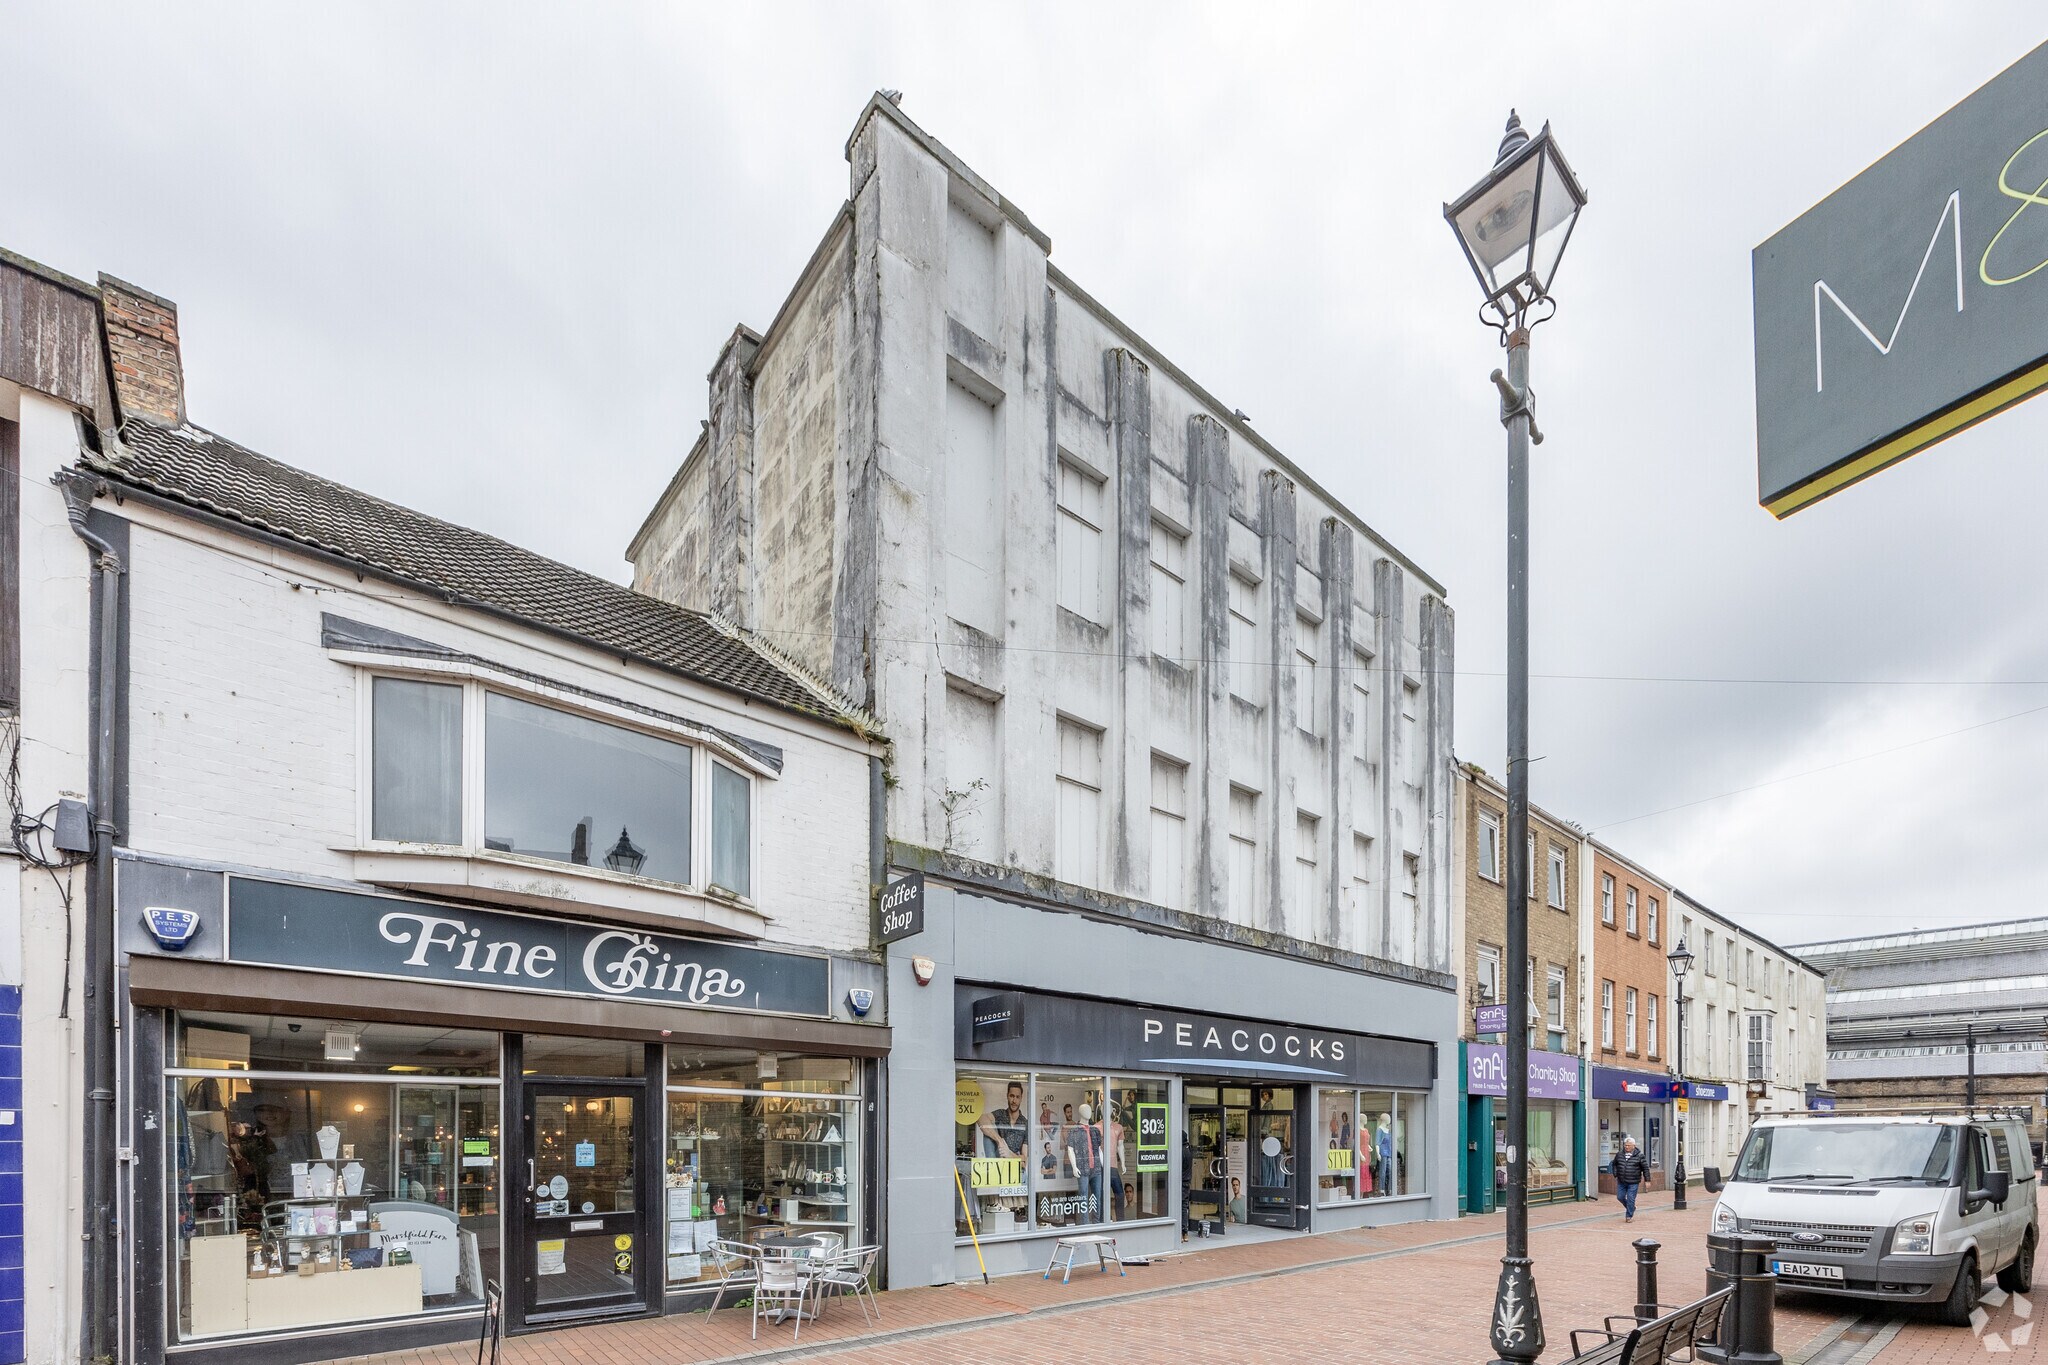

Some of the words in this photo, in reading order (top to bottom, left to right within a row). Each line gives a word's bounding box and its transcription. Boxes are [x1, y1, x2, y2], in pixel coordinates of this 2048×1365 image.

[880, 883, 917, 913] Coffee
[154, 920, 188, 928] SYSTEMS
[883, 910, 913, 935] Shop
[379, 912, 557, 978] Fine
[582, 931, 746, 1004] China
[975, 1010, 1012, 1023] PEACOCKS
[1480, 1008, 1508, 1021] enfy
[1144, 1019, 1345, 1061] PEACOCKS
[1473, 1052, 1508, 1090] enfy
[1528, 1063, 1557, 1086] Charity
[1559, 1067, 1577, 1087] Shop
[1695, 1085, 1715, 1098] shoezone
[957, 1104, 975, 1114] 3XL
[1141, 1118, 1165, 1135] 30%
[972, 1160, 1026, 1186] STYLE
[1000, 1188, 1012, 1196] FOR
[1013, 1187, 1027, 1195] LESS
[1067, 1195, 1088, 1203] upstairs
[1050, 1201, 1088, 1216] mens
[1783, 1263, 1811, 1275] EA12
[1813, 1266, 1839, 1278] YTL
